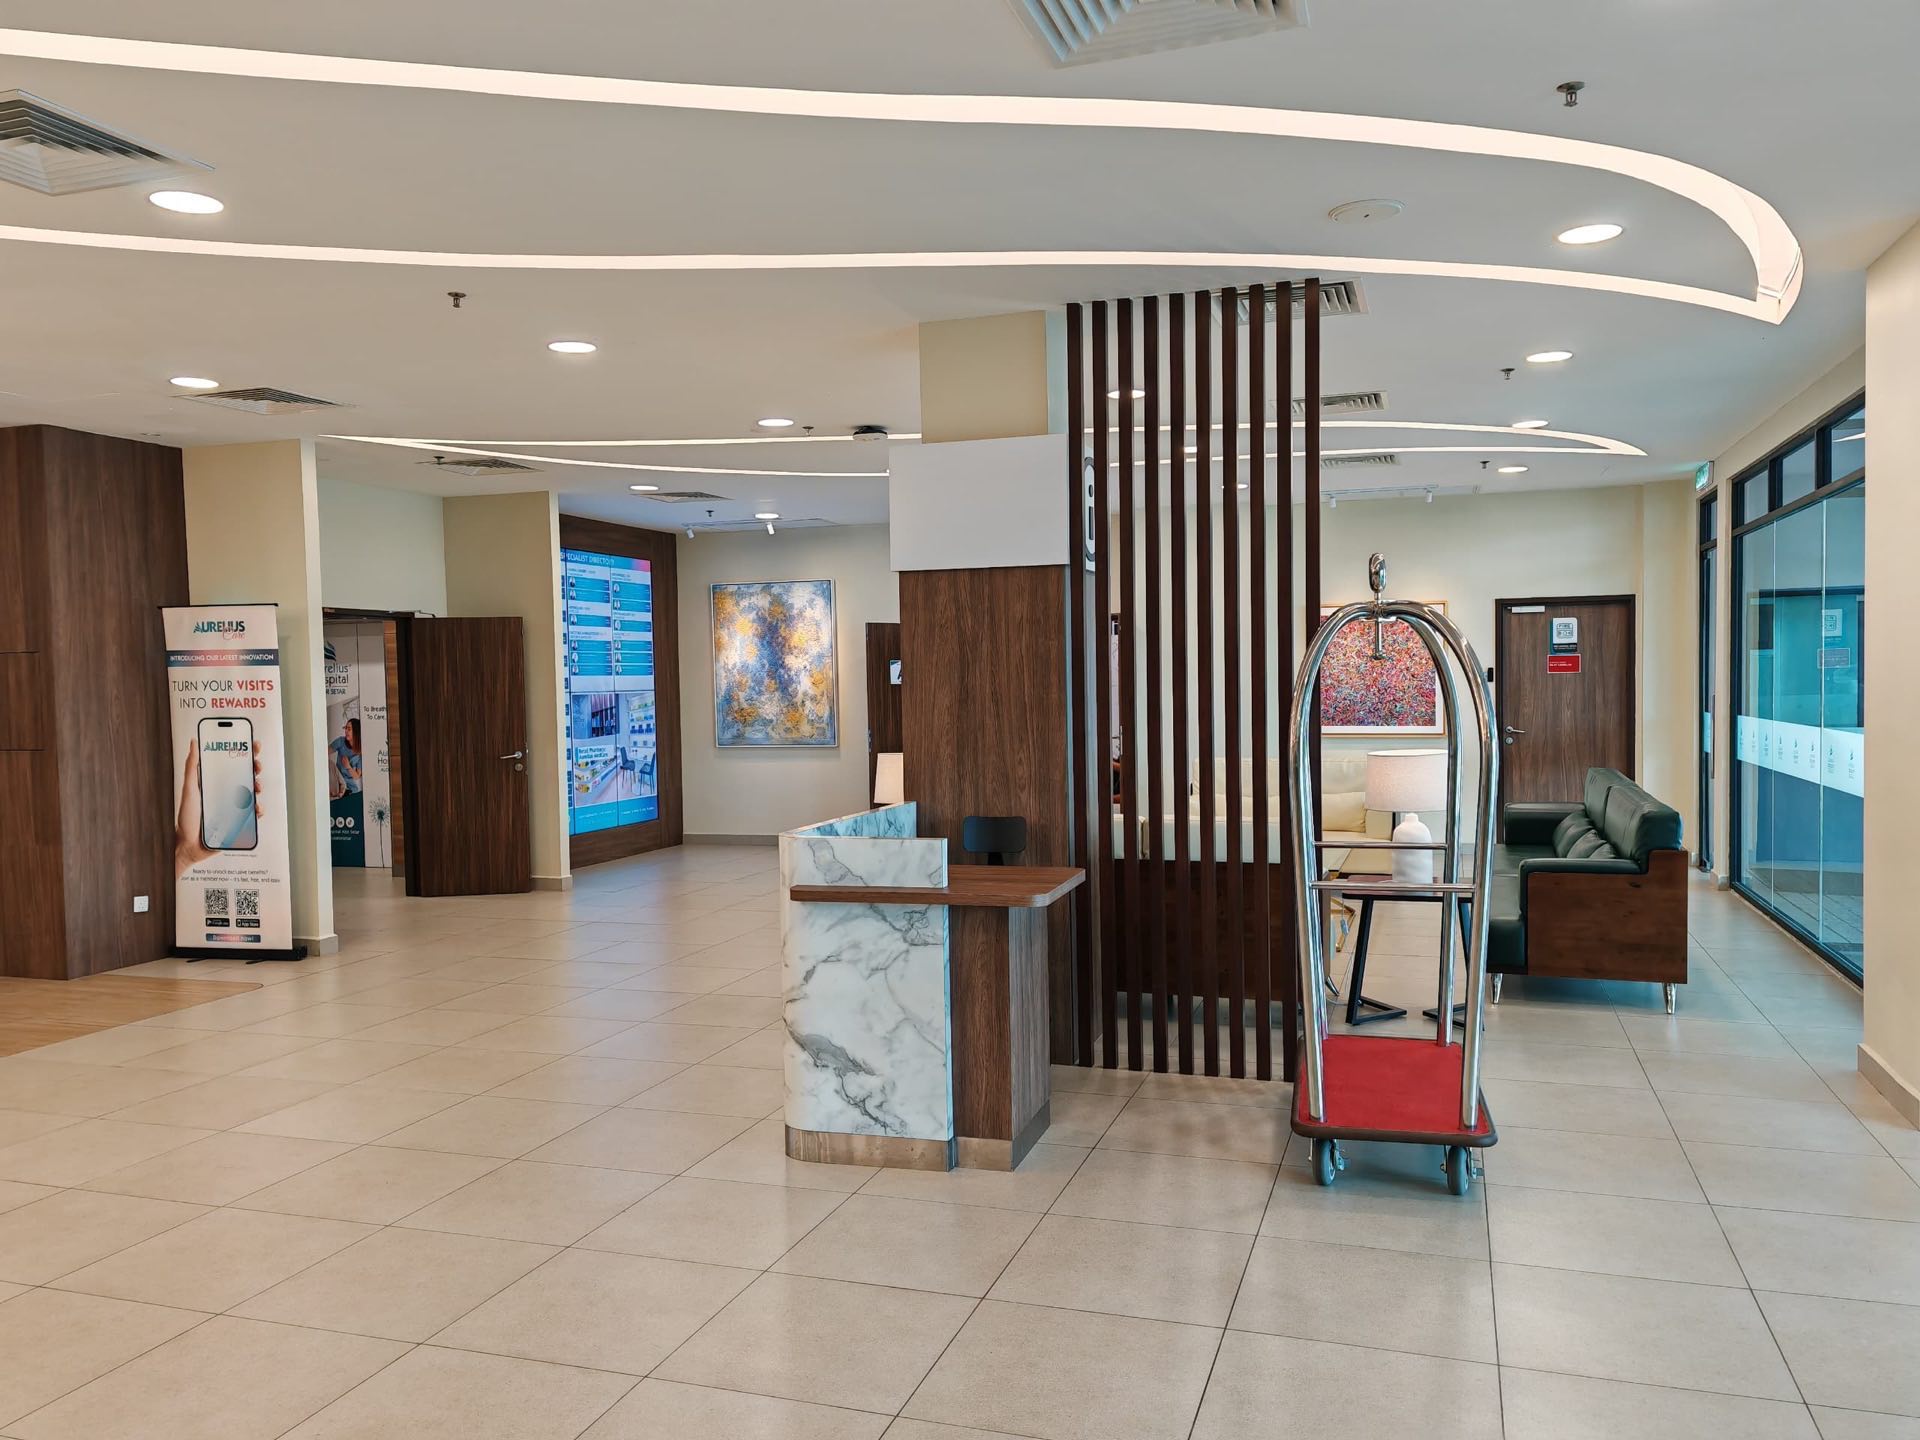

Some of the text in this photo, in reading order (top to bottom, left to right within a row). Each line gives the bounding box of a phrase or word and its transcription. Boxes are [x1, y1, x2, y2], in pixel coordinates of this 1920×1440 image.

[193, 620, 245, 634] AURELIUS
[239, 653, 274, 661] INNOVATION
[172, 679, 274, 691] TURN YOUR VISITS
[179, 697, 266, 709] INTO REWARDS
[203, 741, 249, 752] AURELIUS
